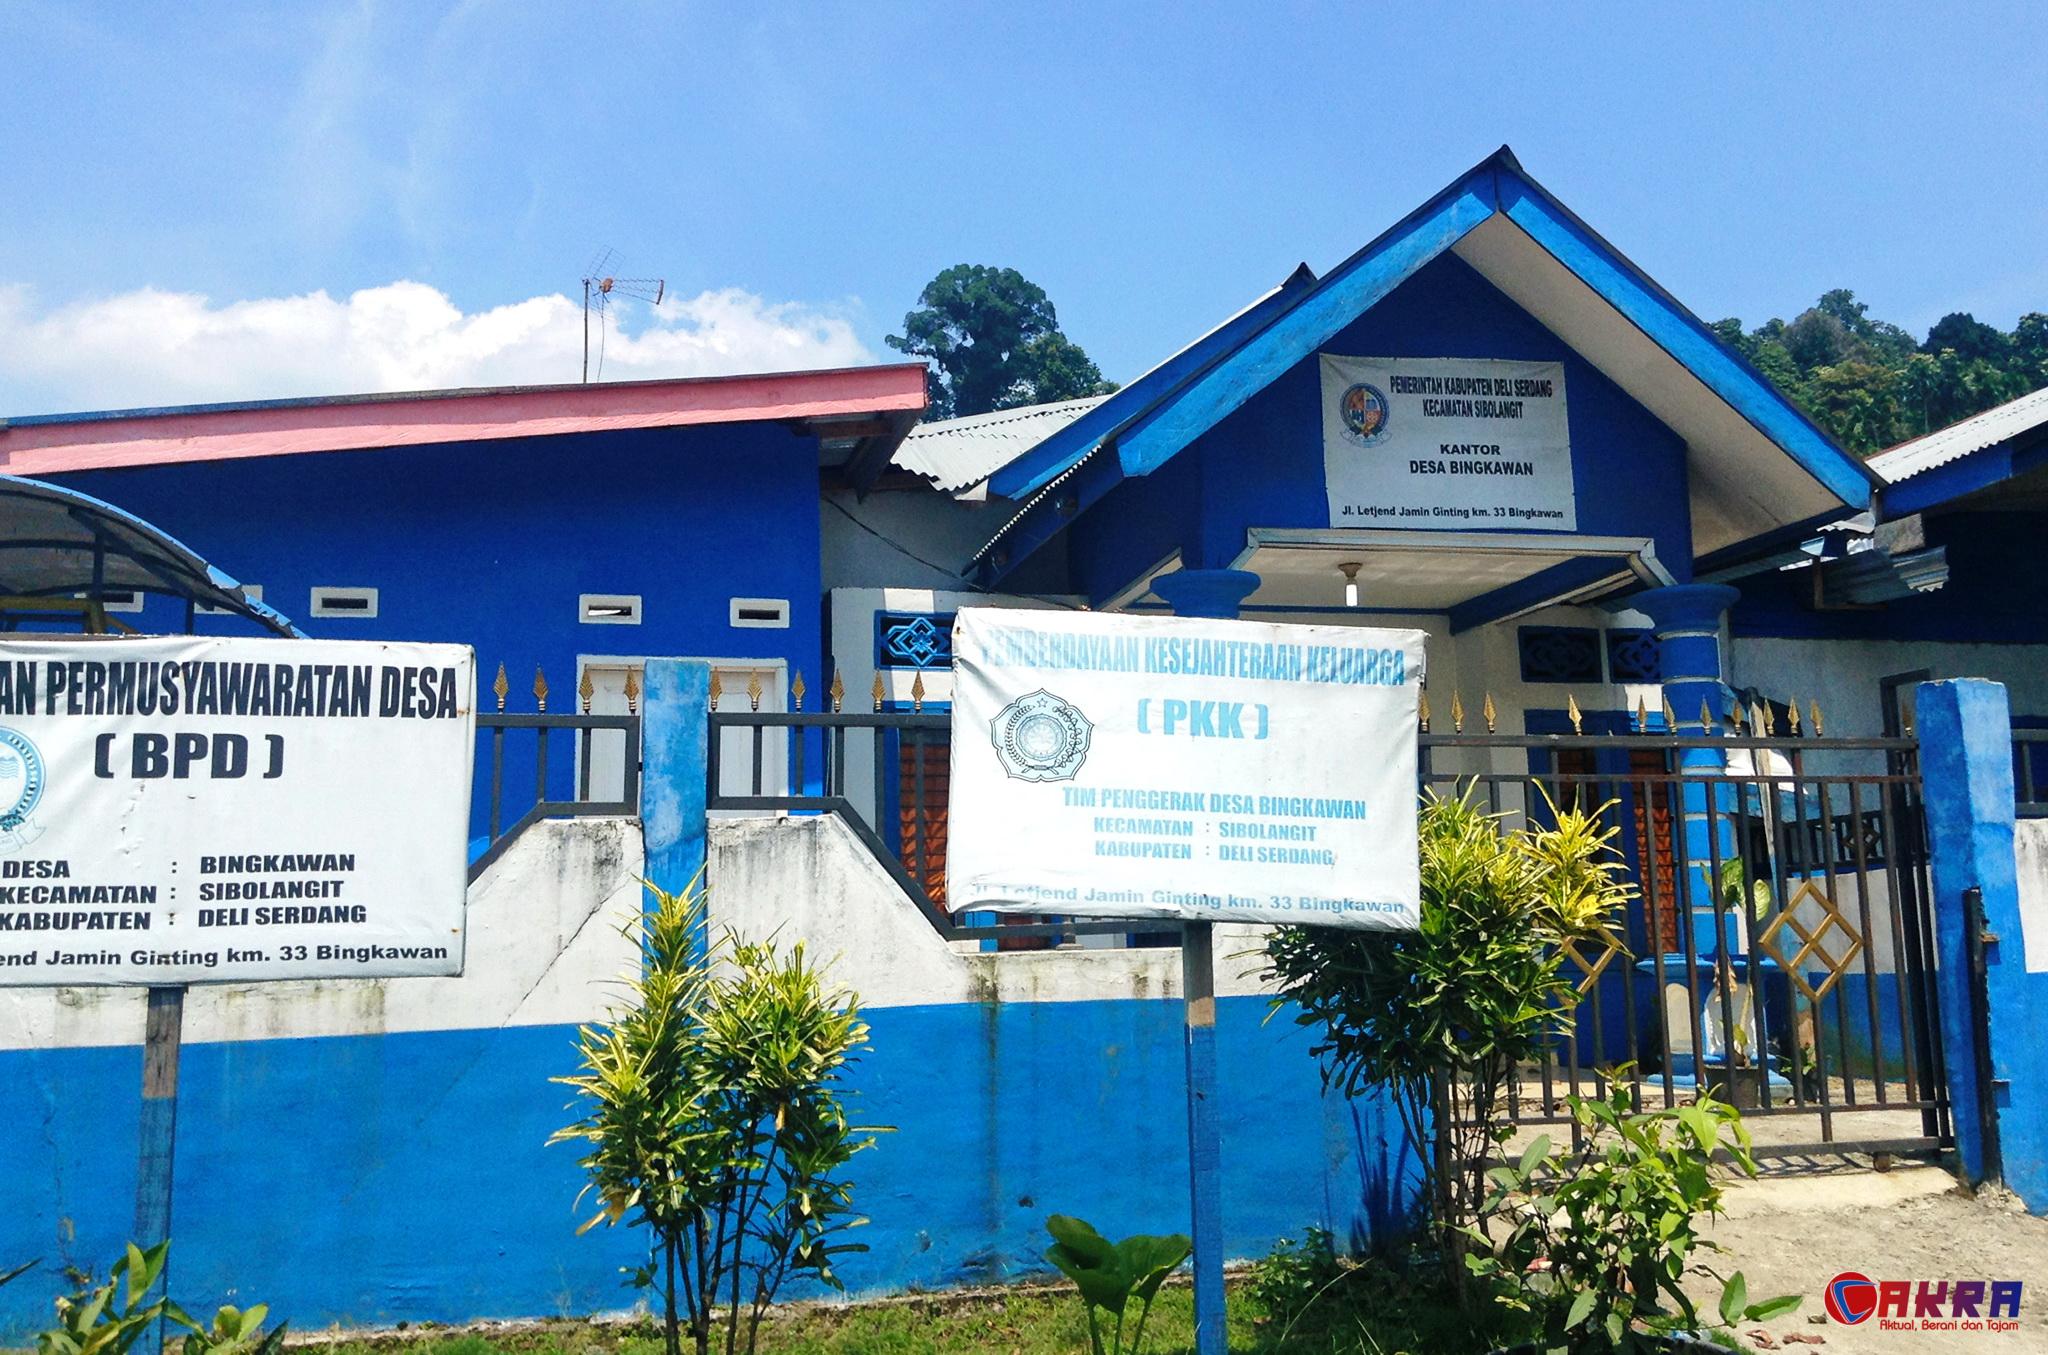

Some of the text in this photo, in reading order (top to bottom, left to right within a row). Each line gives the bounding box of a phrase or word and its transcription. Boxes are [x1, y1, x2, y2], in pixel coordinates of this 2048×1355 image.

[1390, 376, 1553, 398] PEMERINTAH KABUPATEN DELI SERDANG
[1423, 399, 1523, 419] KECAMATAN SIBOLANGIT
[1440, 444, 1500, 455] KANTOR
[1410, 460, 1533, 476] DESA BINGKAWAN
[1357, 505, 1396, 518] Letjend
[1399, 507, 1430, 517] Jamin
[1432, 506, 1470, 519] Ginting
[1472, 508, 1491, 517] km.
[1493, 508, 1506, 518] 33
[1508, 508, 1564, 520] Bingkawan
[1144, 636, 1301, 682] KESEJAHTERAAN
[1306, 645, 1406, 686] KELUARGA
[46, 661, 372, 718] PERMUSYAWARATAN
[379, 665, 458, 720] DESA
[1062, 786, 1367, 820] TIM PENGGERAK DESA BINGKAWAN
[1094, 817, 1194, 837] KECAMATAN
[1219, 821, 1317, 842] SIBOLANGIT
[1095, 840, 1192, 860] KABUPATEN
[1219, 845, 1255, 862] DELI
[1257, 846, 1334, 866] SERDANG
[2, 860, 70, 879] DESA
[200, 854, 355, 874] BINGKAWAN
[0, 886, 157, 905] KECAMATAN
[199, 880, 345, 901] SIBOLANGIT
[1084, 888, 1144, 903] Jamin
[1151, 889, 1221, 909] Ginting
[1228, 894, 1262, 909] km.
[1270, 896, 1293, 910] 33
[1299, 896, 1404, 914] Bingkawan
[0, 912, 151, 931] KABUPATEN
[198, 908, 249, 927] DELI
[255, 905, 367, 925] SERDANG
[45, 950, 122, 966] Jamin
[130, 950, 218, 968] Ginting
[227, 948, 271, 963] km.
[279, 946, 308, 961] 33
[316, 944, 448, 963] Bingkawan
